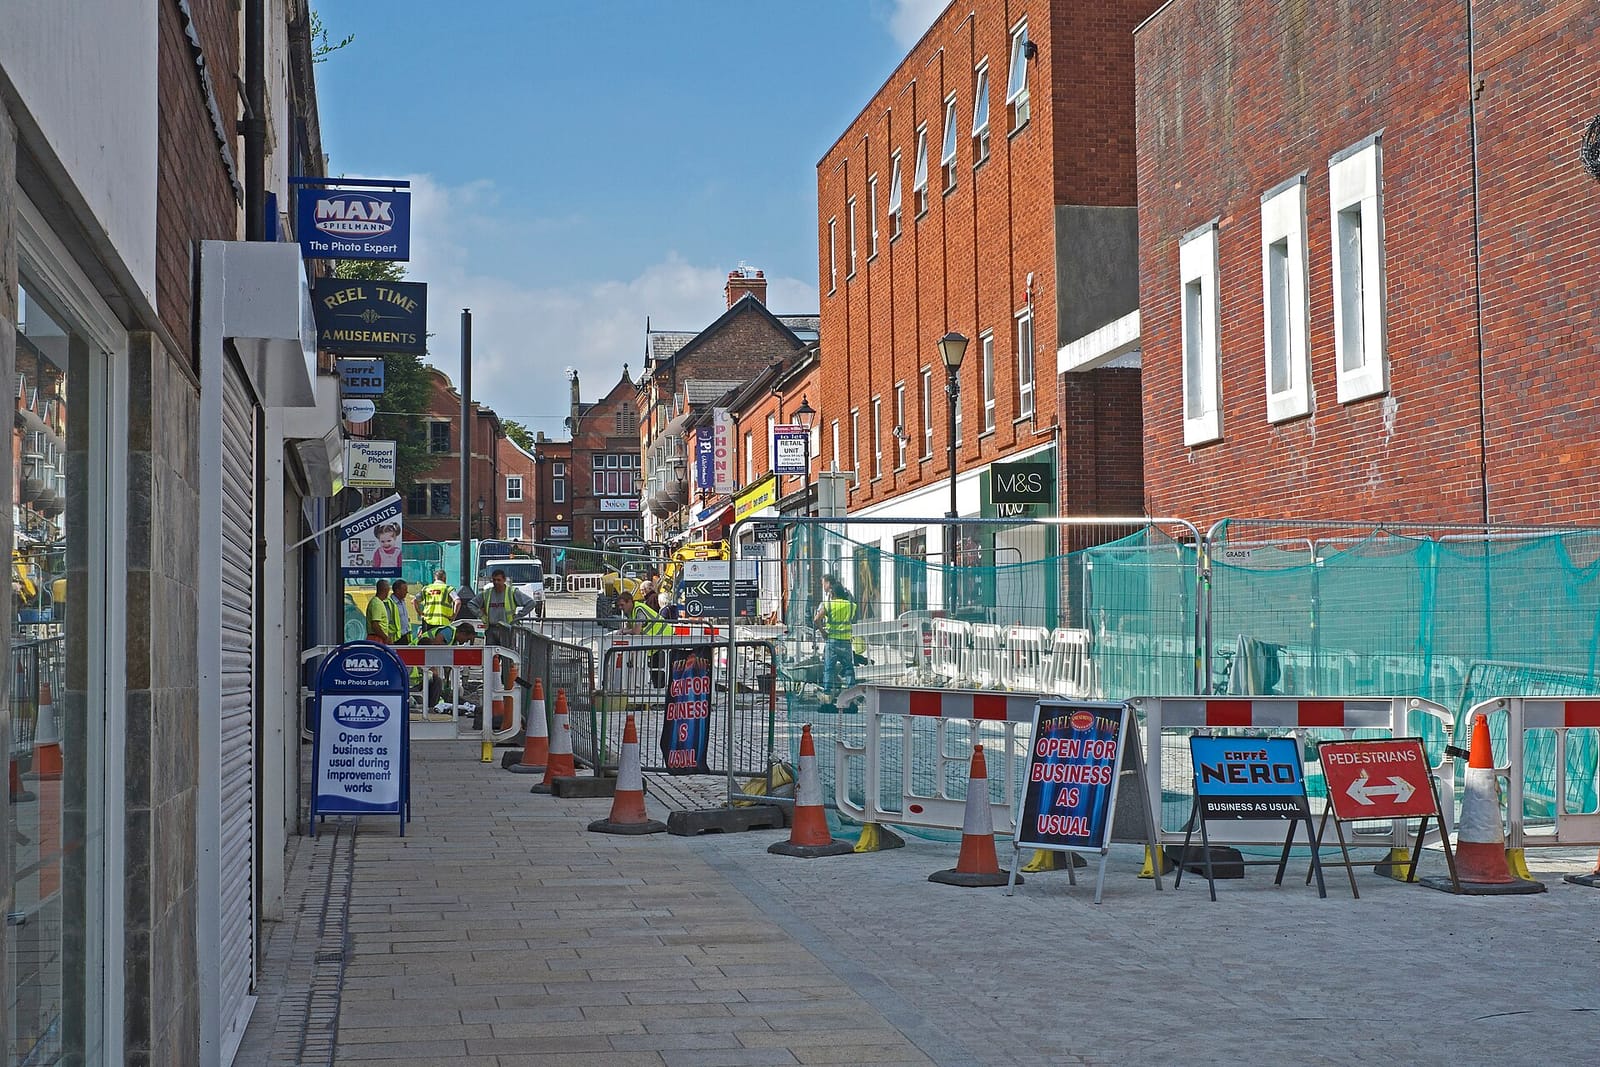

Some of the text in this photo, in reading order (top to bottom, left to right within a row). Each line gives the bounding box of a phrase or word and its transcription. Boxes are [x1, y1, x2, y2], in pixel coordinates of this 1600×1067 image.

[317, 200, 392, 221] MAX
[323, 222, 385, 231] SPIELMANN
[310, 241, 398, 254] The Photo Expert
[323, 287, 418, 314] REEL TIME
[322, 330, 417, 344] AMUSEMENTS
[362, 449, 393, 457] Passport
[715, 425, 727, 483] PHONE
[997, 473, 1042, 493] M&S
[345, 506, 397, 537] PORTRAITS
[686, 586, 698, 594] LK
[345, 659, 379, 668] MAX
[338, 705, 386, 718] MAX
[339, 732, 383, 745] Open for
[332, 744, 388, 755] business as
[1036, 738, 1117, 761] OPEN FOR
[1224, 749, 1268, 761] CAFFÈ
[329, 757, 390, 770] usual during
[1328, 749, 1417, 766] PEDESTRIANS
[327, 769, 391, 782] improvement
[1031, 762, 1112, 785] BUSINESS
[1201, 763, 1297, 784] NERO
[344, 782, 373, 793] works
[1056, 788, 1080, 807] AS
[1207, 802, 1300, 812] BUSINESS AS USUAL
[1037, 814, 1090, 837] USUAL
